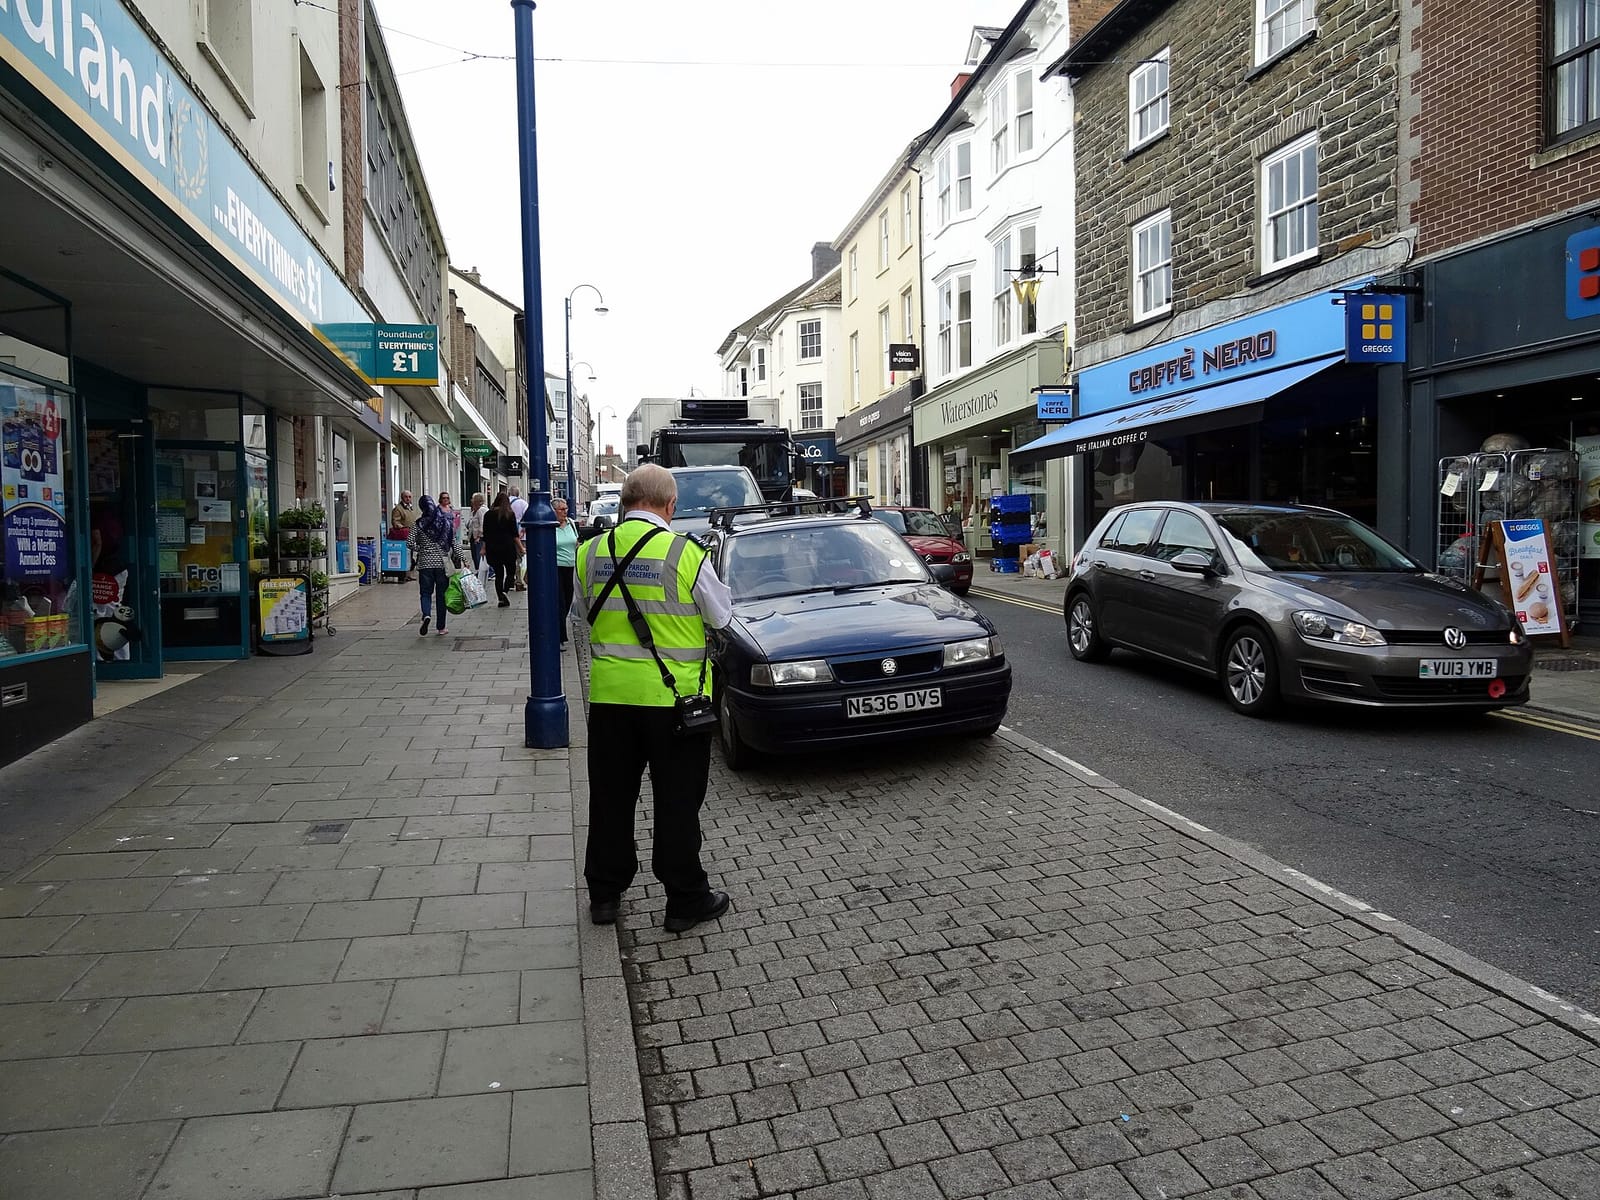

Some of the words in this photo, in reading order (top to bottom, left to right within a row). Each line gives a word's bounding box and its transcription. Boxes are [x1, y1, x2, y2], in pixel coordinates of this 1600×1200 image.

[377, 330, 424, 339] Poundland
[378, 341, 434, 350] EVERYTHING'S
[1202, 329, 1276, 375] NERO
[1362, 345, 1393, 353] GREGGS
[392, 351, 419, 372] £1
[941, 389, 999, 425] Waterstones
[463, 446, 489, 454] Specsavers
[1076, 443, 1087, 453] THE
[1088, 438, 1111, 450] ITALIAN
[1112, 433, 1137, 446] COFFEE
[1515, 523, 1540, 531] GREGGS
[17, 538, 31, 551] WIN
[32, 541, 36, 551] a
[19, 552, 41, 566] Annual
[42, 552, 57, 566] Pass
[188, 566, 222, 581] Fre
[1433, 661, 1464, 676] VU13
[1468, 661, 1493, 676] YWB
[847, 694, 898, 716] N536
[903, 690, 940, 709] DVS
